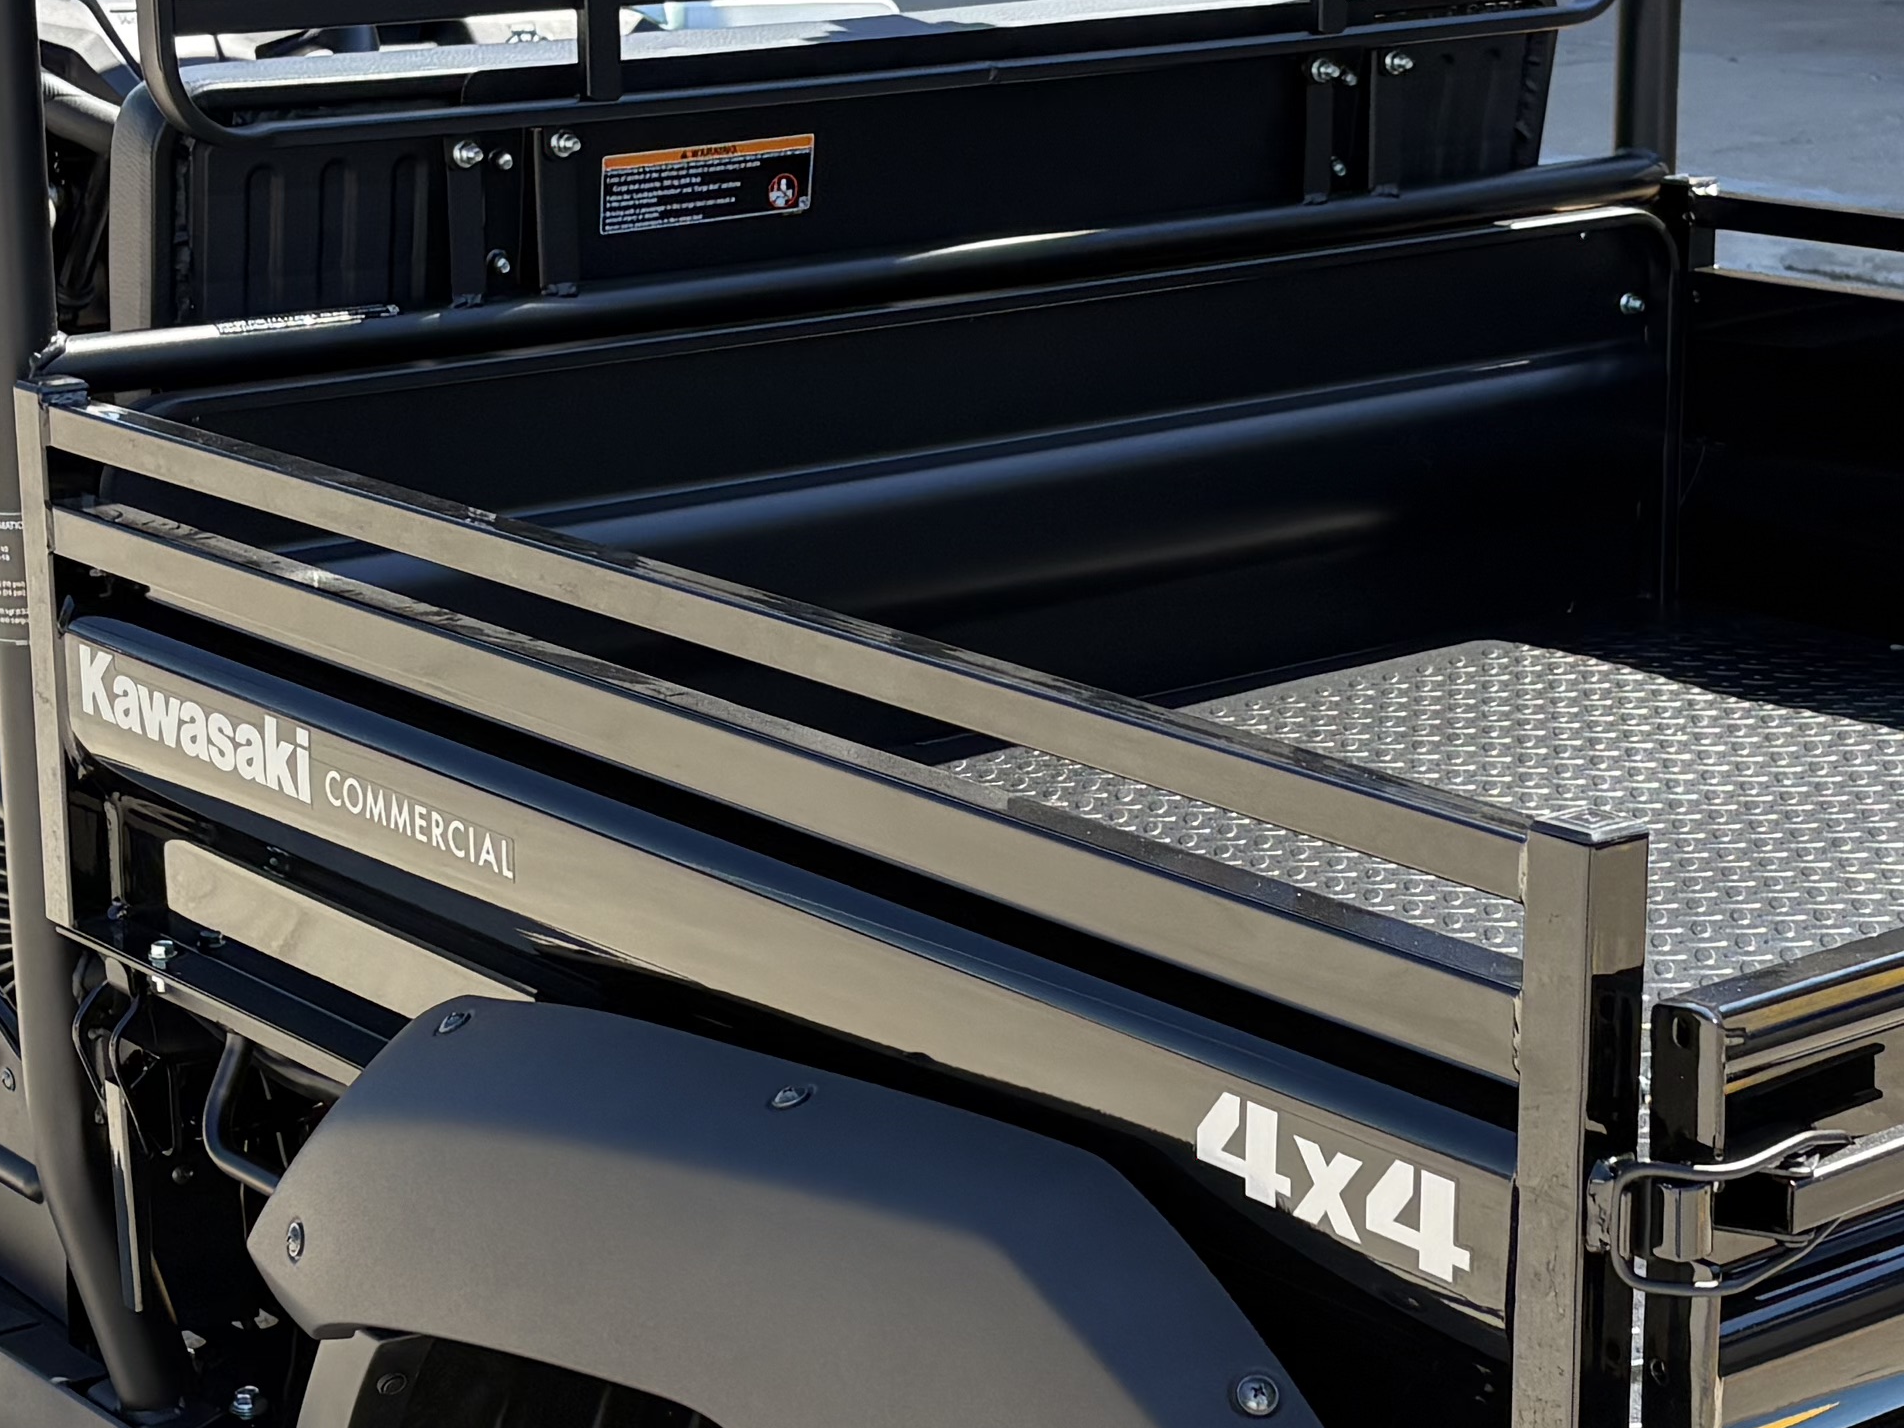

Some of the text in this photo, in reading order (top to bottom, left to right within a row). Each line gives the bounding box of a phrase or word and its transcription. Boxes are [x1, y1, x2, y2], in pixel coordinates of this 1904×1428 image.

[79, 644, 514, 880] Kawasaki COMMERCIAL
[1196, 1090, 1471, 1283] 4x4
